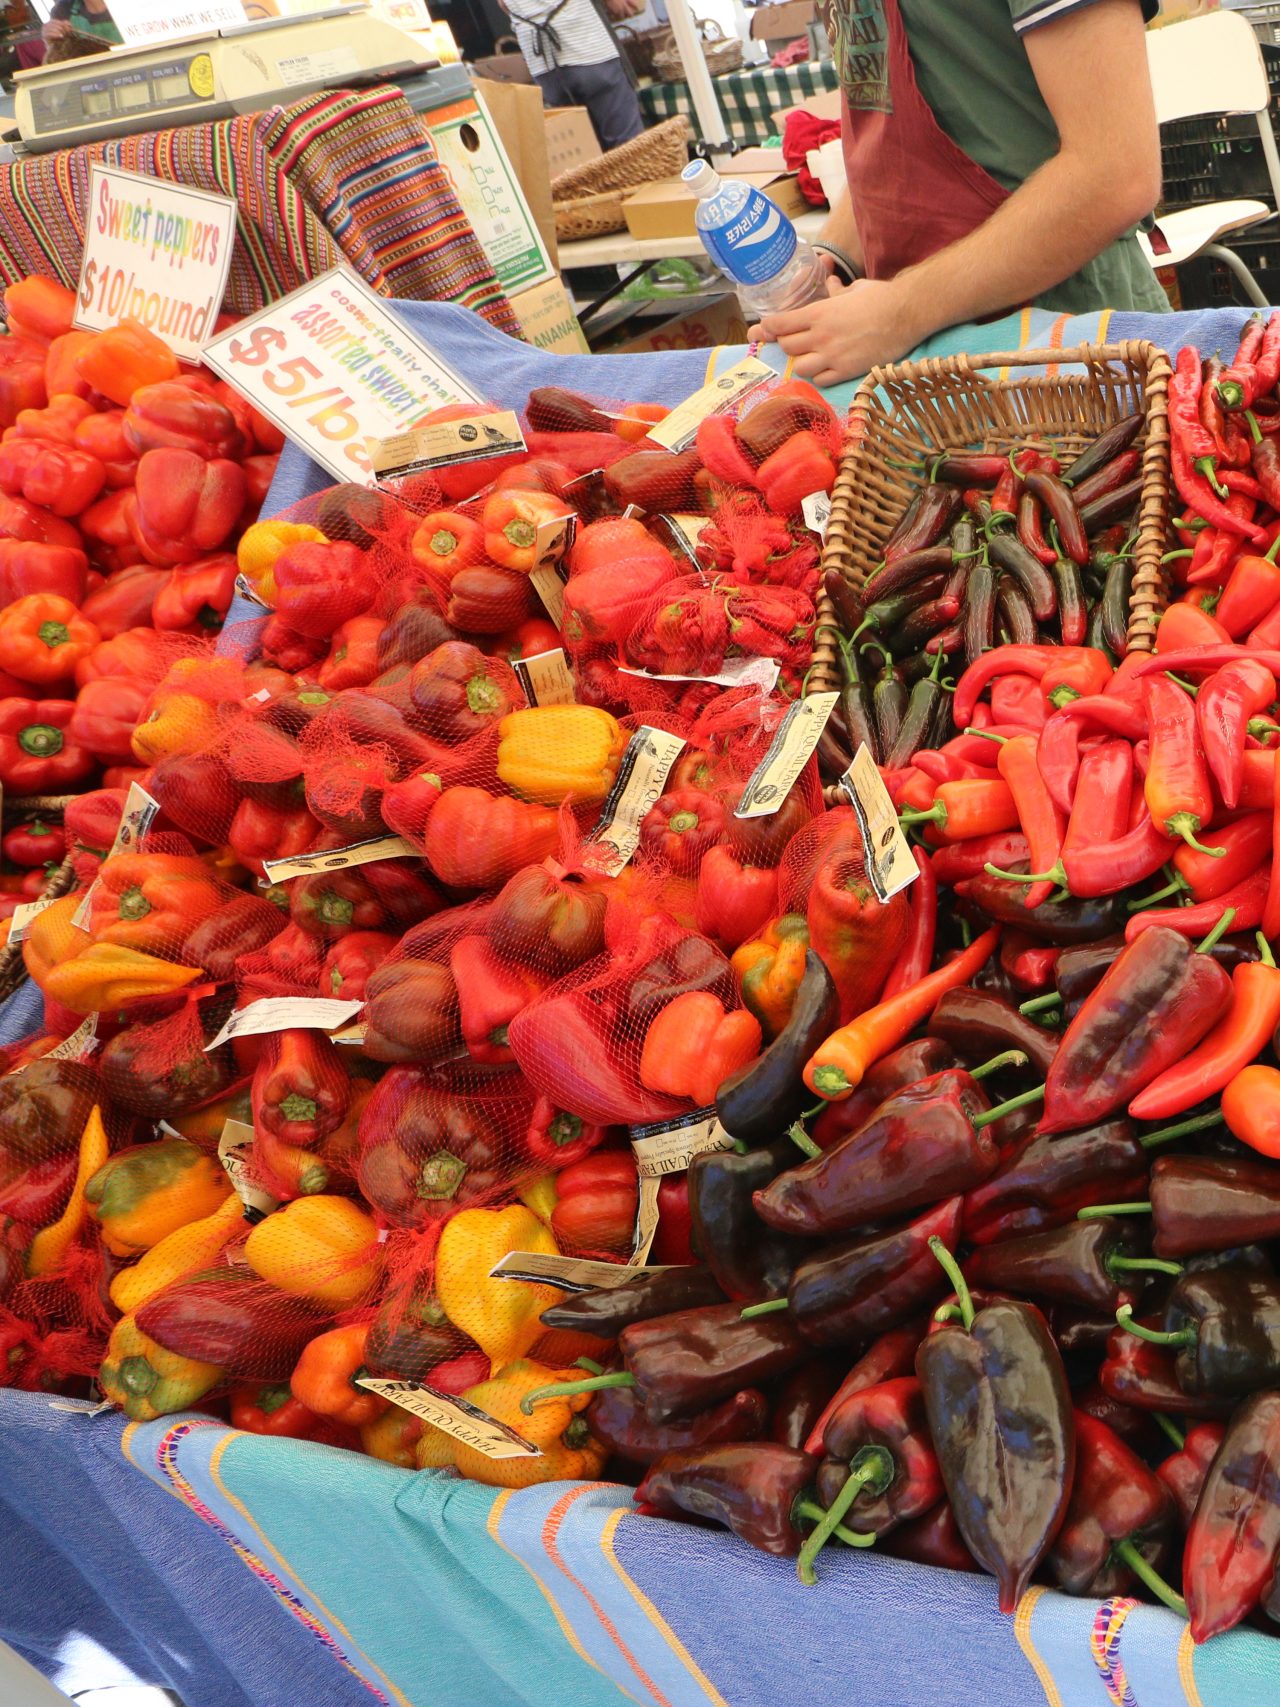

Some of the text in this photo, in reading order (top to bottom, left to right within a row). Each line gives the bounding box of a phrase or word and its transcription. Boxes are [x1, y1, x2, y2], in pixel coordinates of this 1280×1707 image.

[124, 7, 238, 37] WE GROW WHAT WE SELL
[97, 178, 220, 270] Sweet peppers
[725, 196, 766, 245] 포카리 스위트
[80, 257, 214, 343] $10/pound
[329, 288, 422, 374] cosmetically
[290, 303, 429, 420] assorted sweet
[811, 700, 833, 734] HAPPY
[652, 743, 680, 787] HAPPY
[793, 735, 817, 768] QUAIL
[411, 1403, 455, 1426] QUAIL
[450, 1425, 497, 1452] HAPPY
